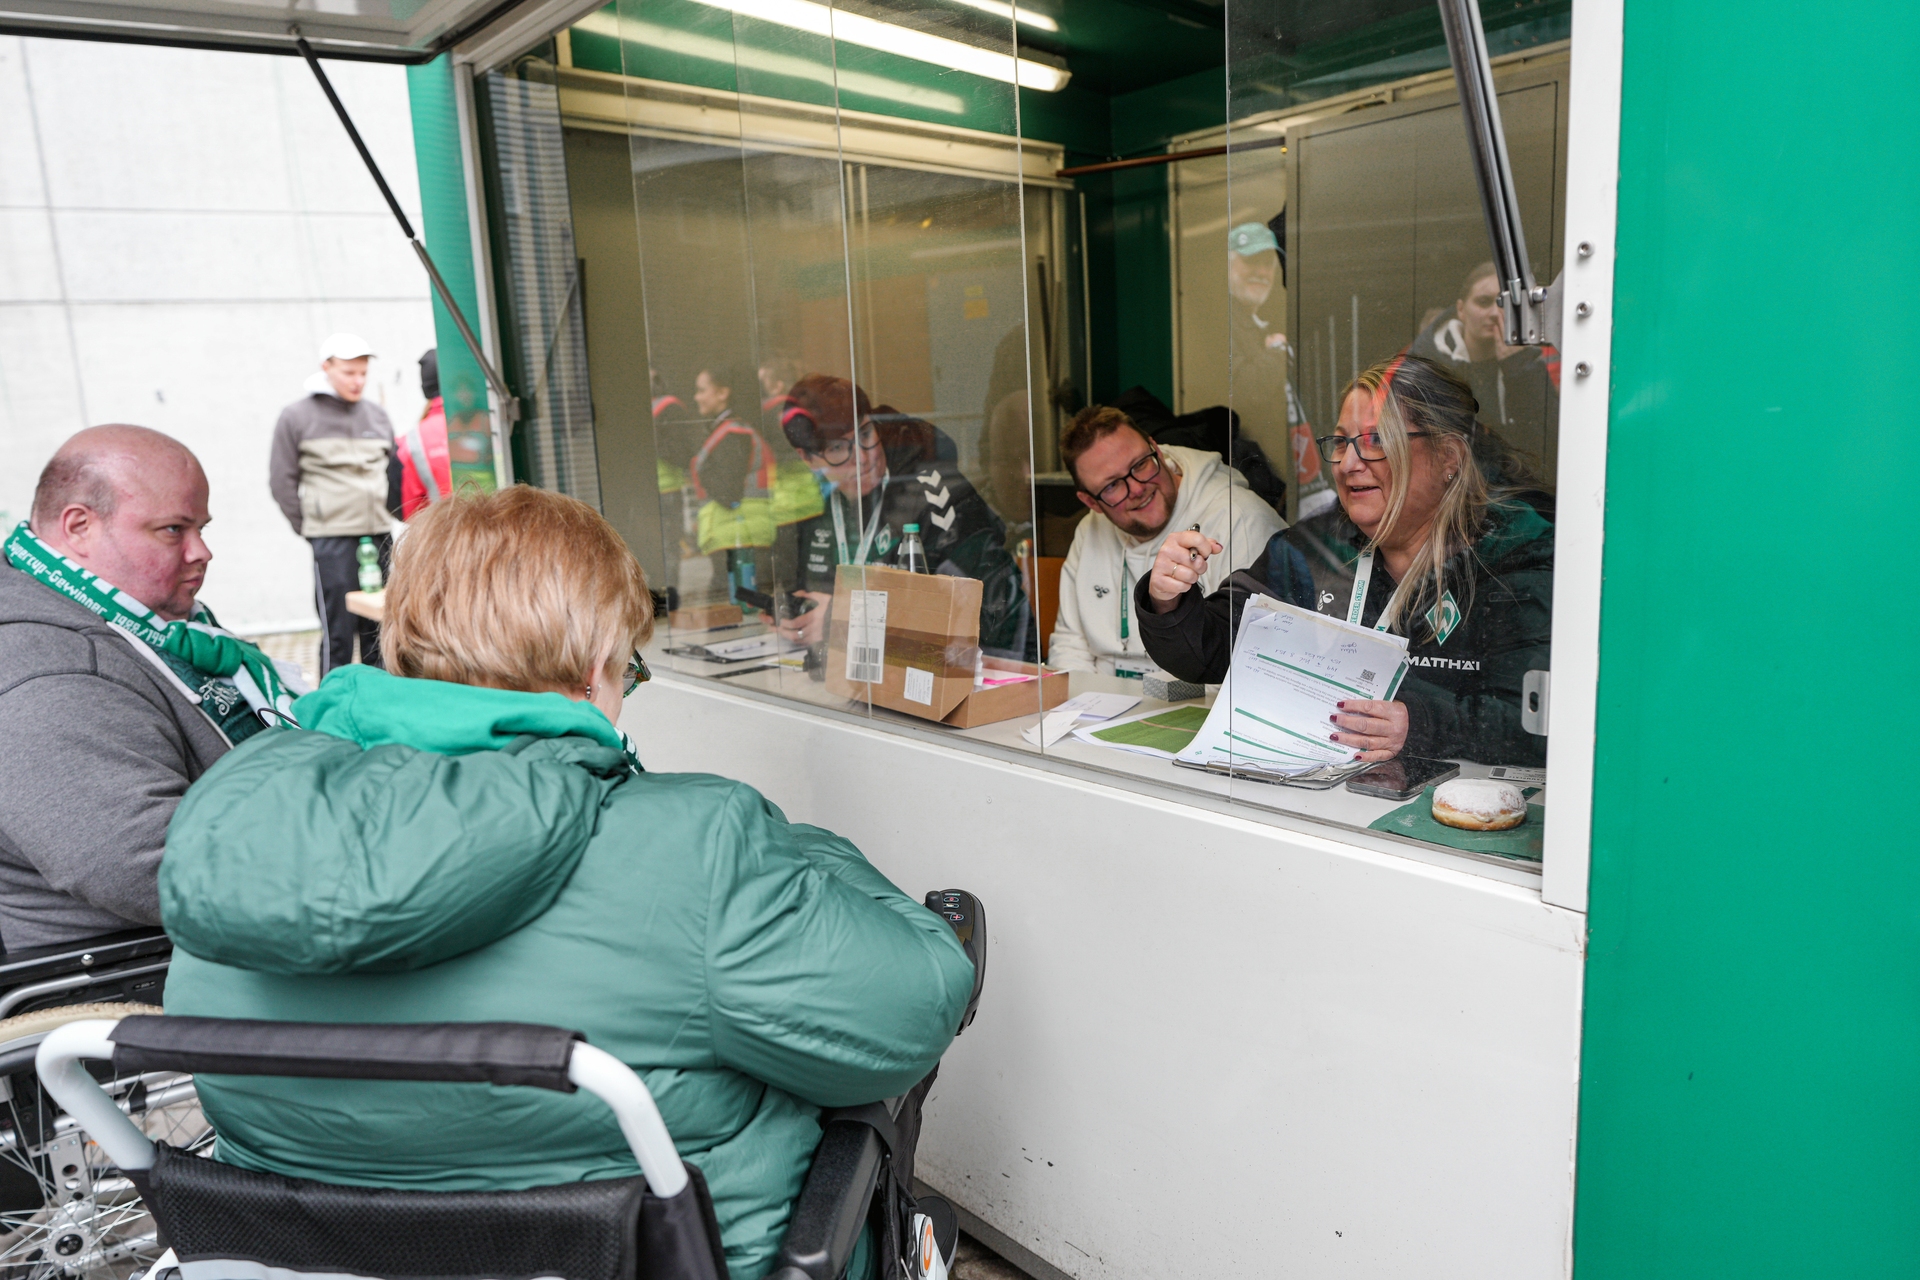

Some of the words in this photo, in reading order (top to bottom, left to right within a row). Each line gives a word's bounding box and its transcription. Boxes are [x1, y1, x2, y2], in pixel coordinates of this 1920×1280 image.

[7, 536, 108, 615] Supercup-Gewinner
[1355, 579, 1366, 601] STROM
[1350, 602, 1361, 624] ERDER
[1407, 656, 1480, 671] MATTHÄI
